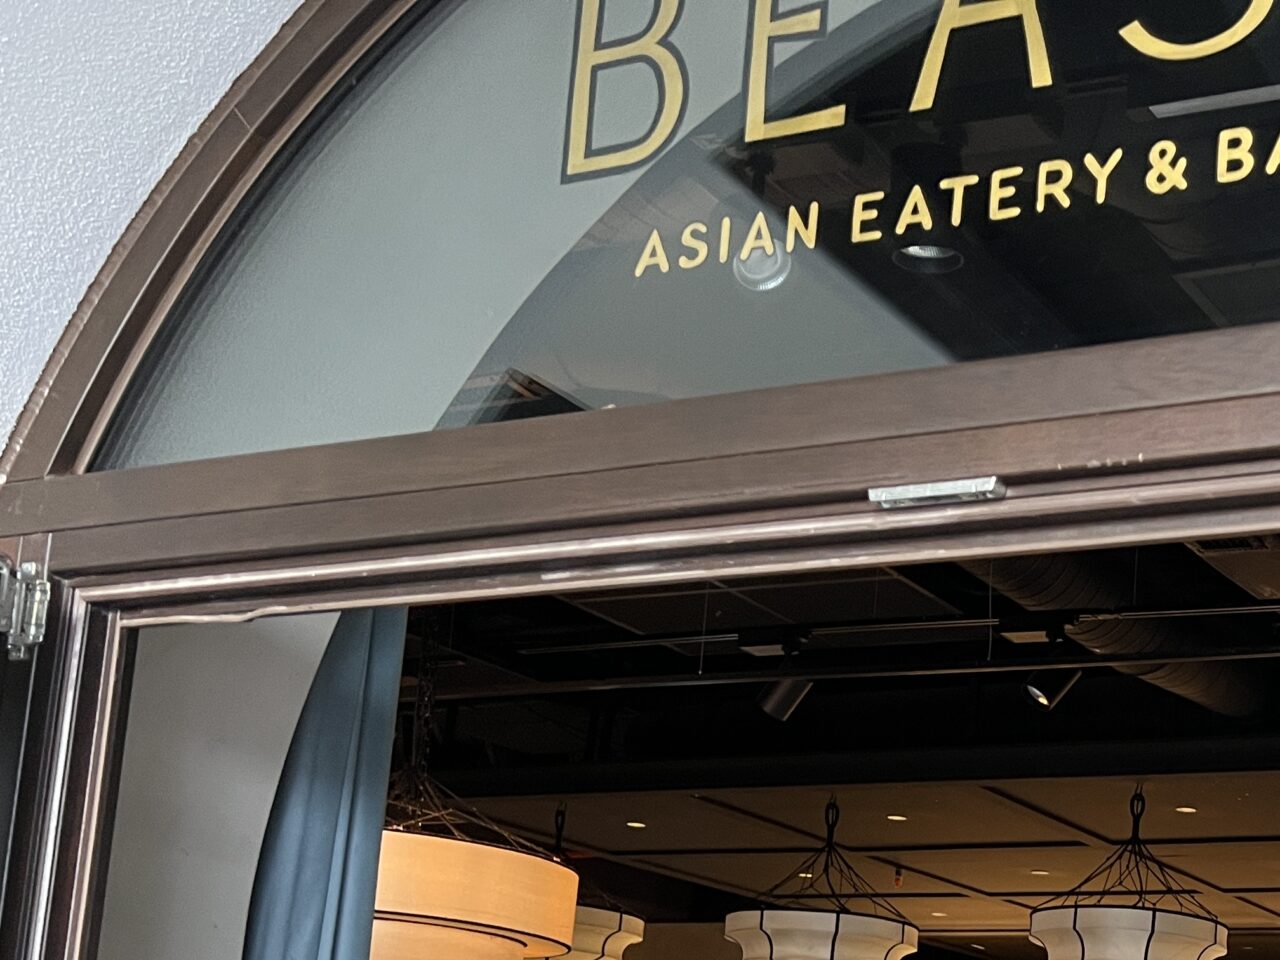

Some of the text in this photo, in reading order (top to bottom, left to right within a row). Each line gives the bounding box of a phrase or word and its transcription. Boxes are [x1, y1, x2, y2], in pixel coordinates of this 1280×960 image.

[634, 201, 821, 279] ASIAN
[851, 149, 1122, 244] EATERY
[1146, 140, 1189, 195] &
